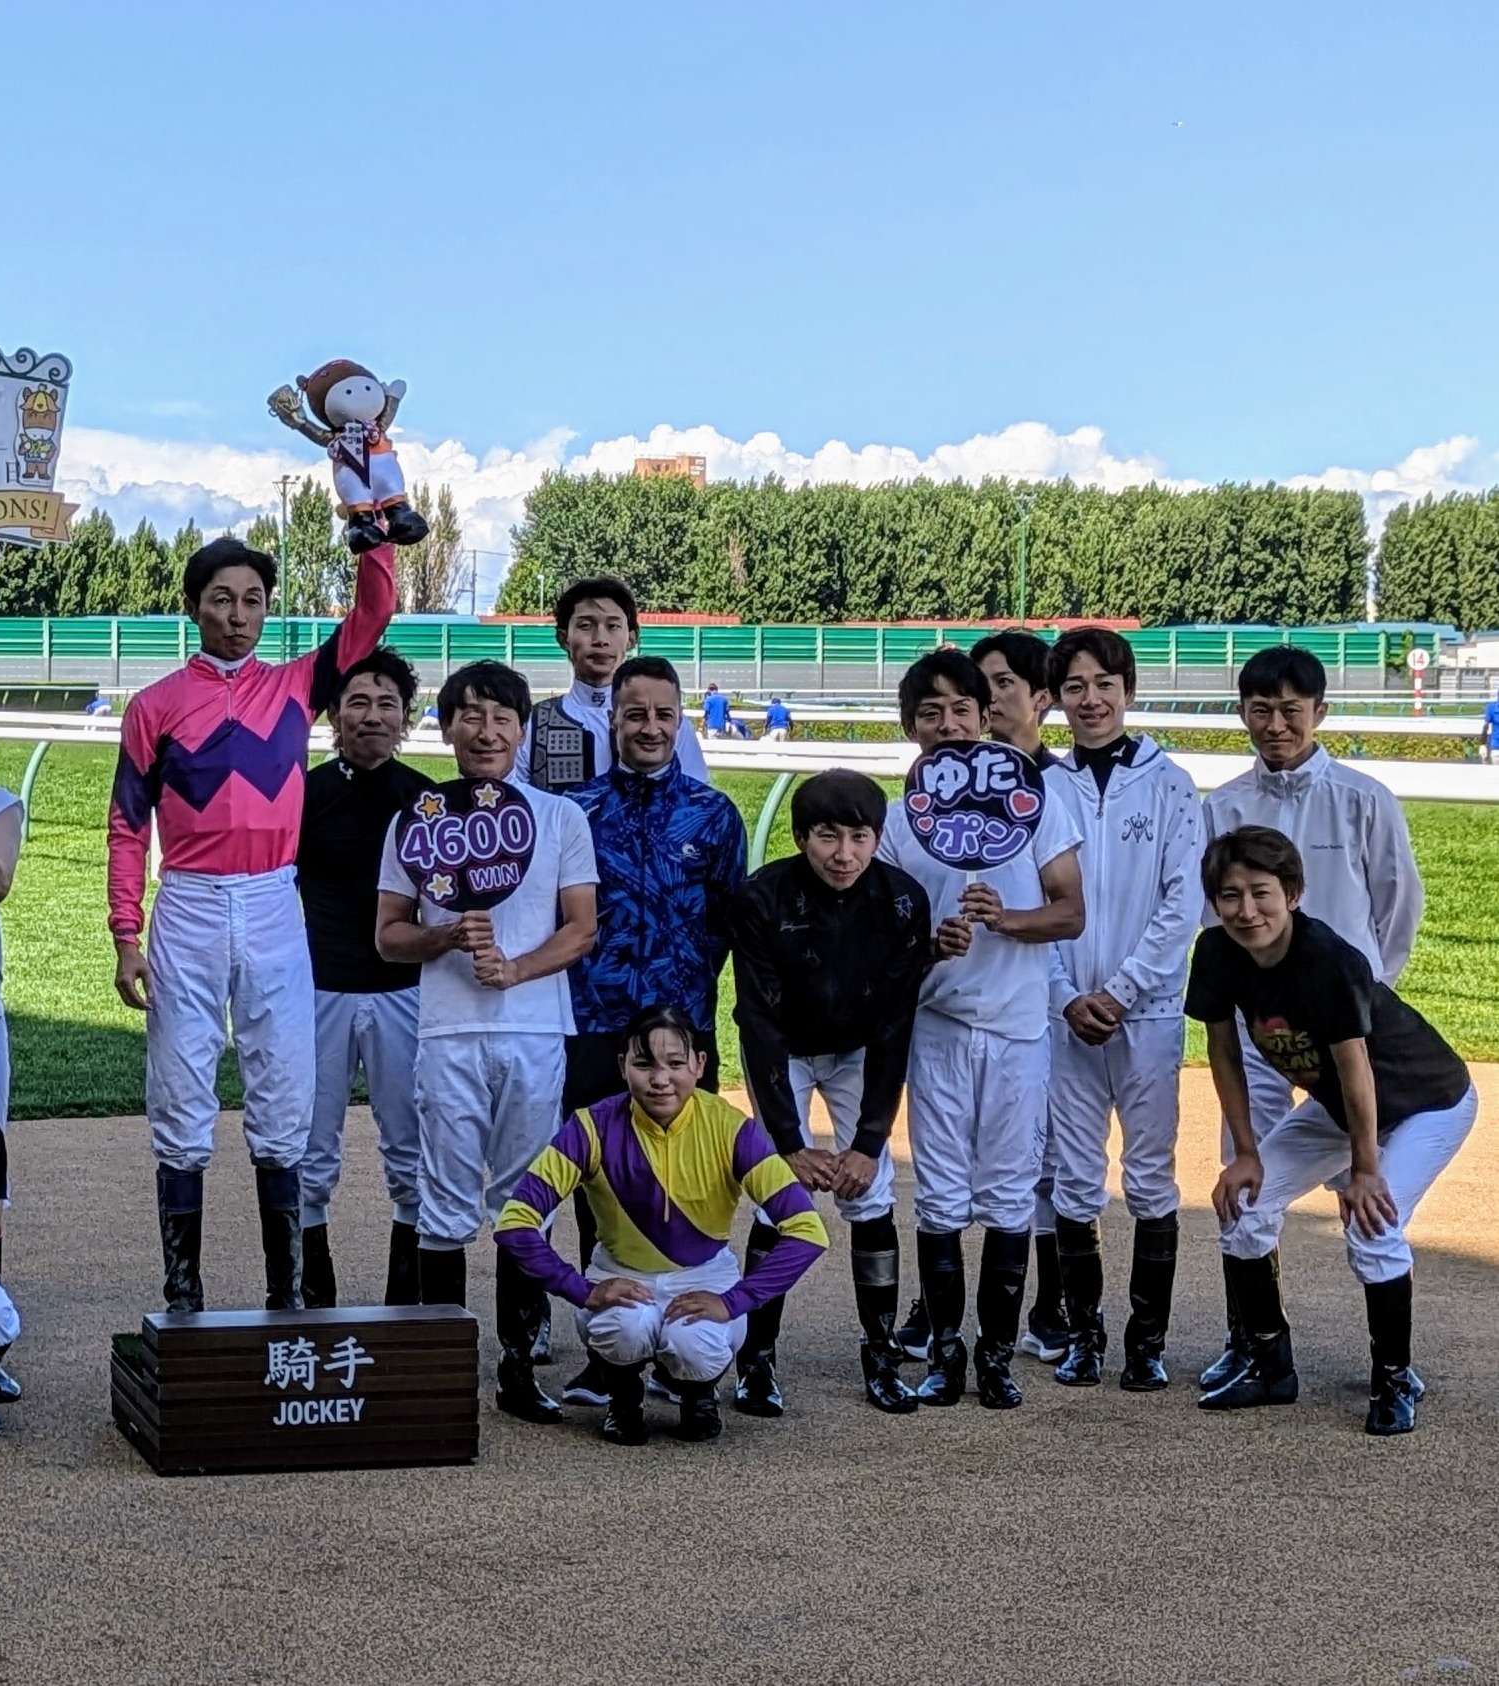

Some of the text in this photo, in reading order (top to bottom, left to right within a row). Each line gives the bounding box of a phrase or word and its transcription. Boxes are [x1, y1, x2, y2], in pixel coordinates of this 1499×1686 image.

[1412, 651, 1425, 667] 14
[922, 750, 1018, 801] ゆた
[401, 805, 534, 870] 4600
[933, 813, 1028, 861] ポン
[469, 862, 520, 892] WIN
[263, 1335, 376, 1392] 騎手
[272, 1398, 365, 1426] JOCKEY
